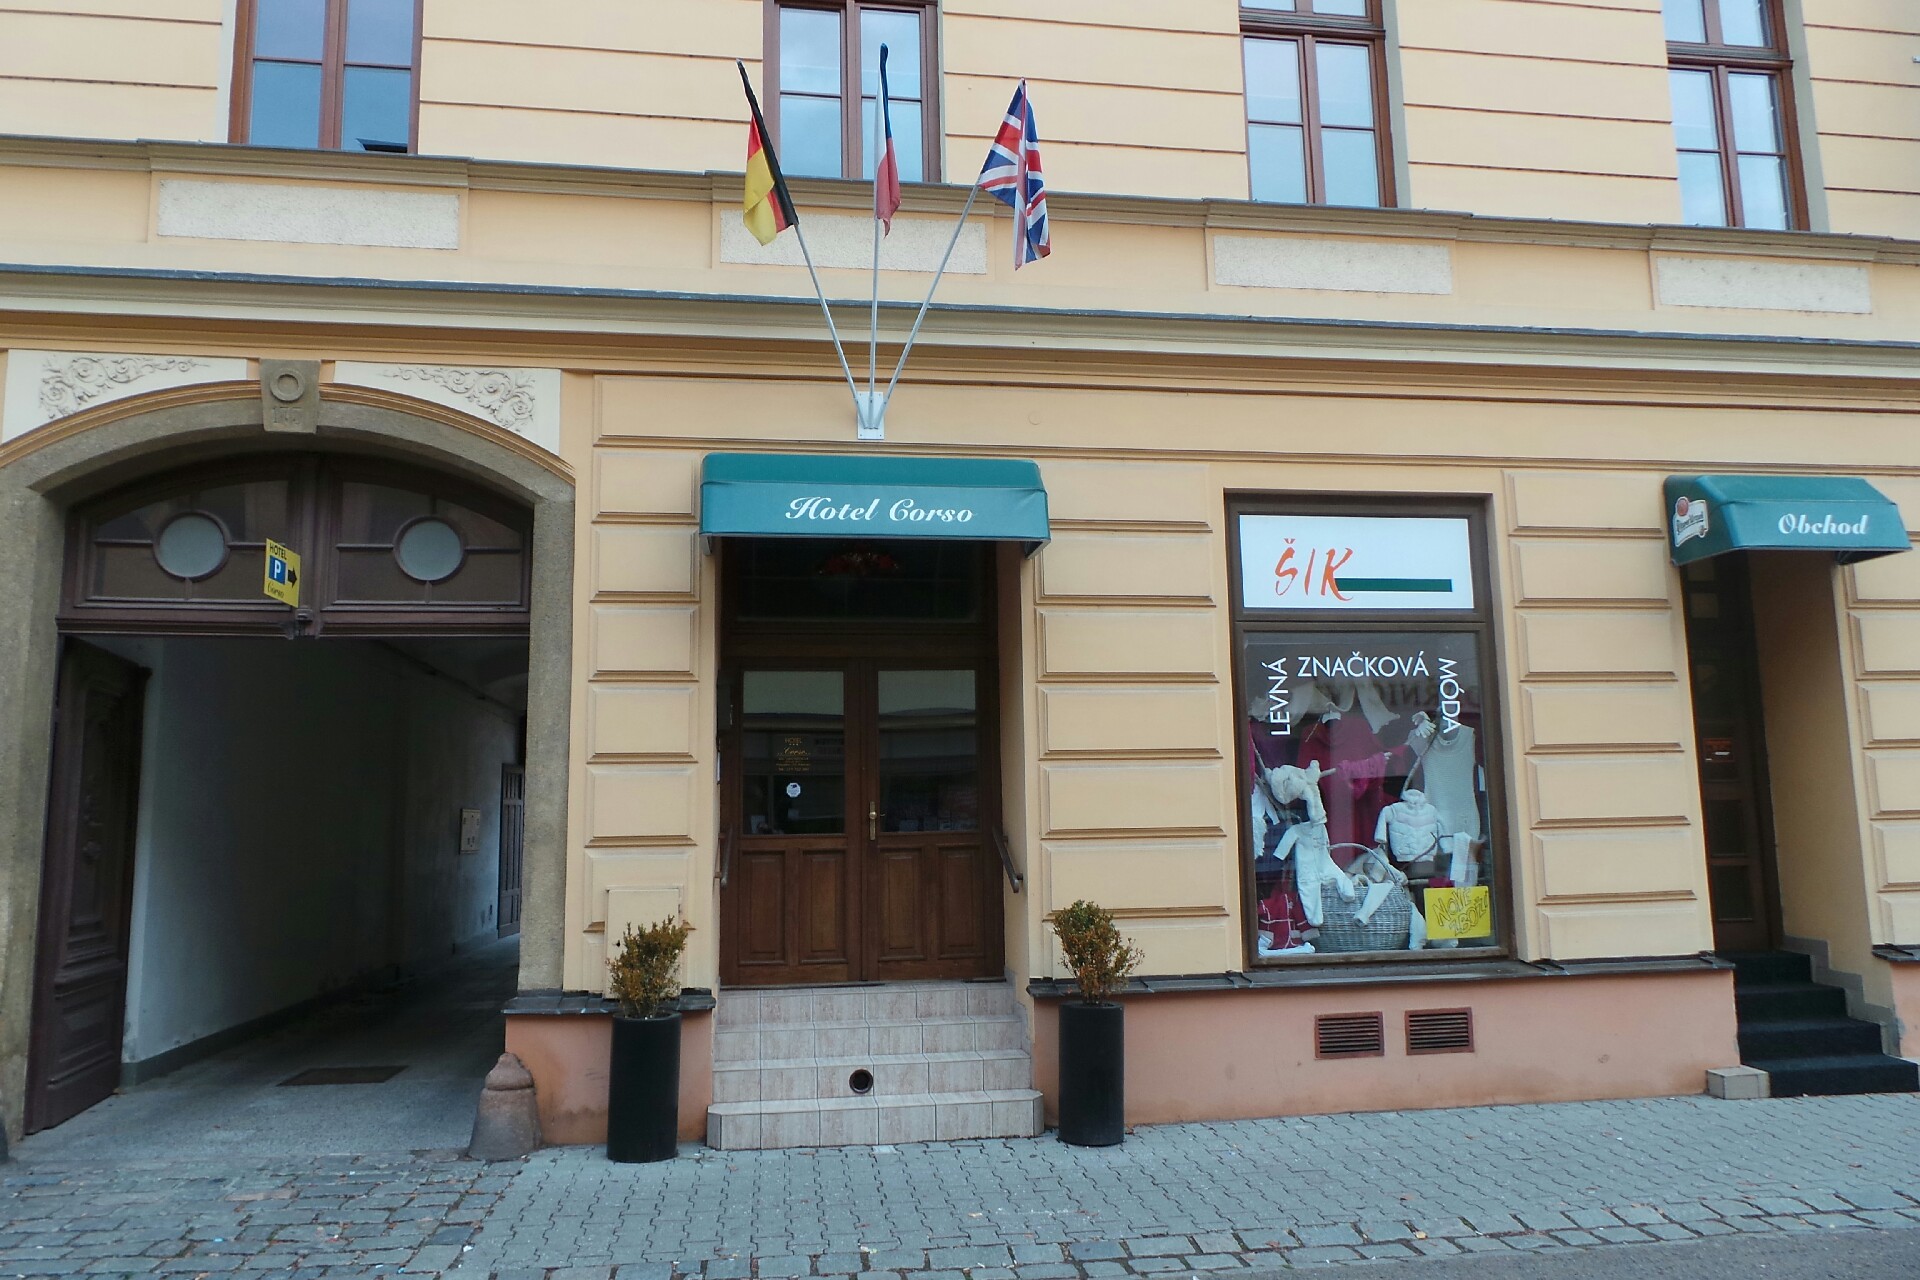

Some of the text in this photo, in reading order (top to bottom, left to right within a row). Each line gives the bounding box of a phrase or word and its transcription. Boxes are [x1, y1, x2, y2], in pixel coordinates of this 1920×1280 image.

[785, 496, 975, 523] Hotel Corso
[1778, 512, 1869, 536] Obchod
[269, 541, 287, 560] HOTEL
[274, 559, 282, 579] P
[1274, 538, 1354, 602] ŠIK
[1297, 650, 1430, 678] ZNAČKOVÁ
[1260, 656, 1291, 737] LEVNÁ
[1437, 657, 1465, 735] MÓDA
